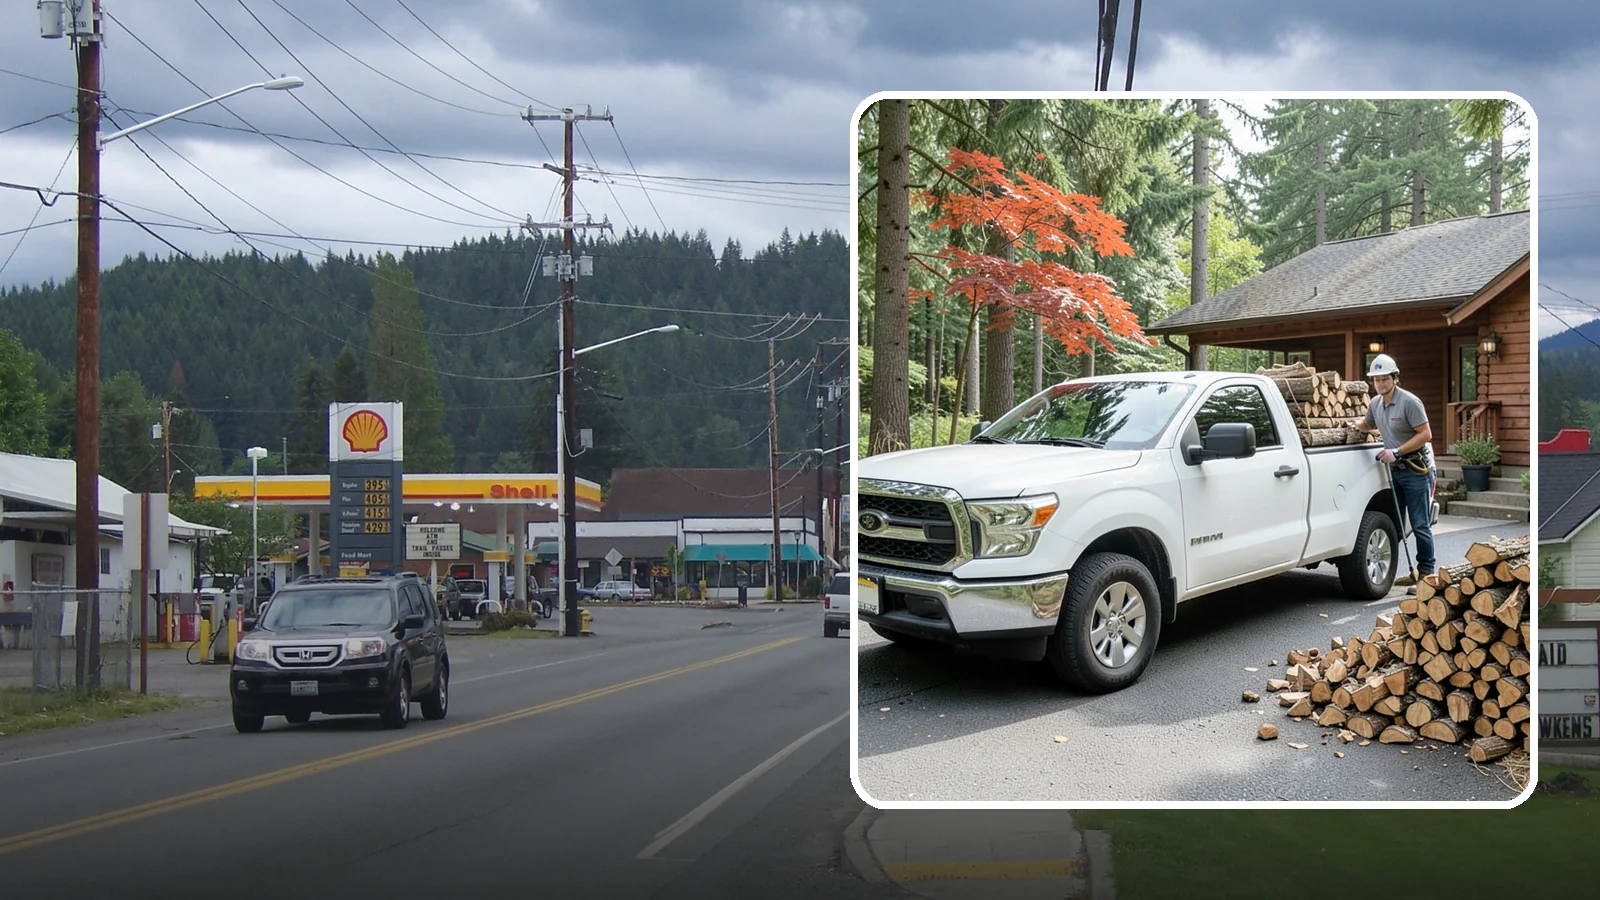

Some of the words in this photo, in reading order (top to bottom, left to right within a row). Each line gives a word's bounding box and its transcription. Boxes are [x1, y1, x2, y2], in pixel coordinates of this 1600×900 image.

[366, 480, 383, 490] 395
[490, 484, 547, 499] Shell
[366, 494, 383, 504] 405
[366, 508, 383, 518] 415
[366, 522, 383, 532] 429
